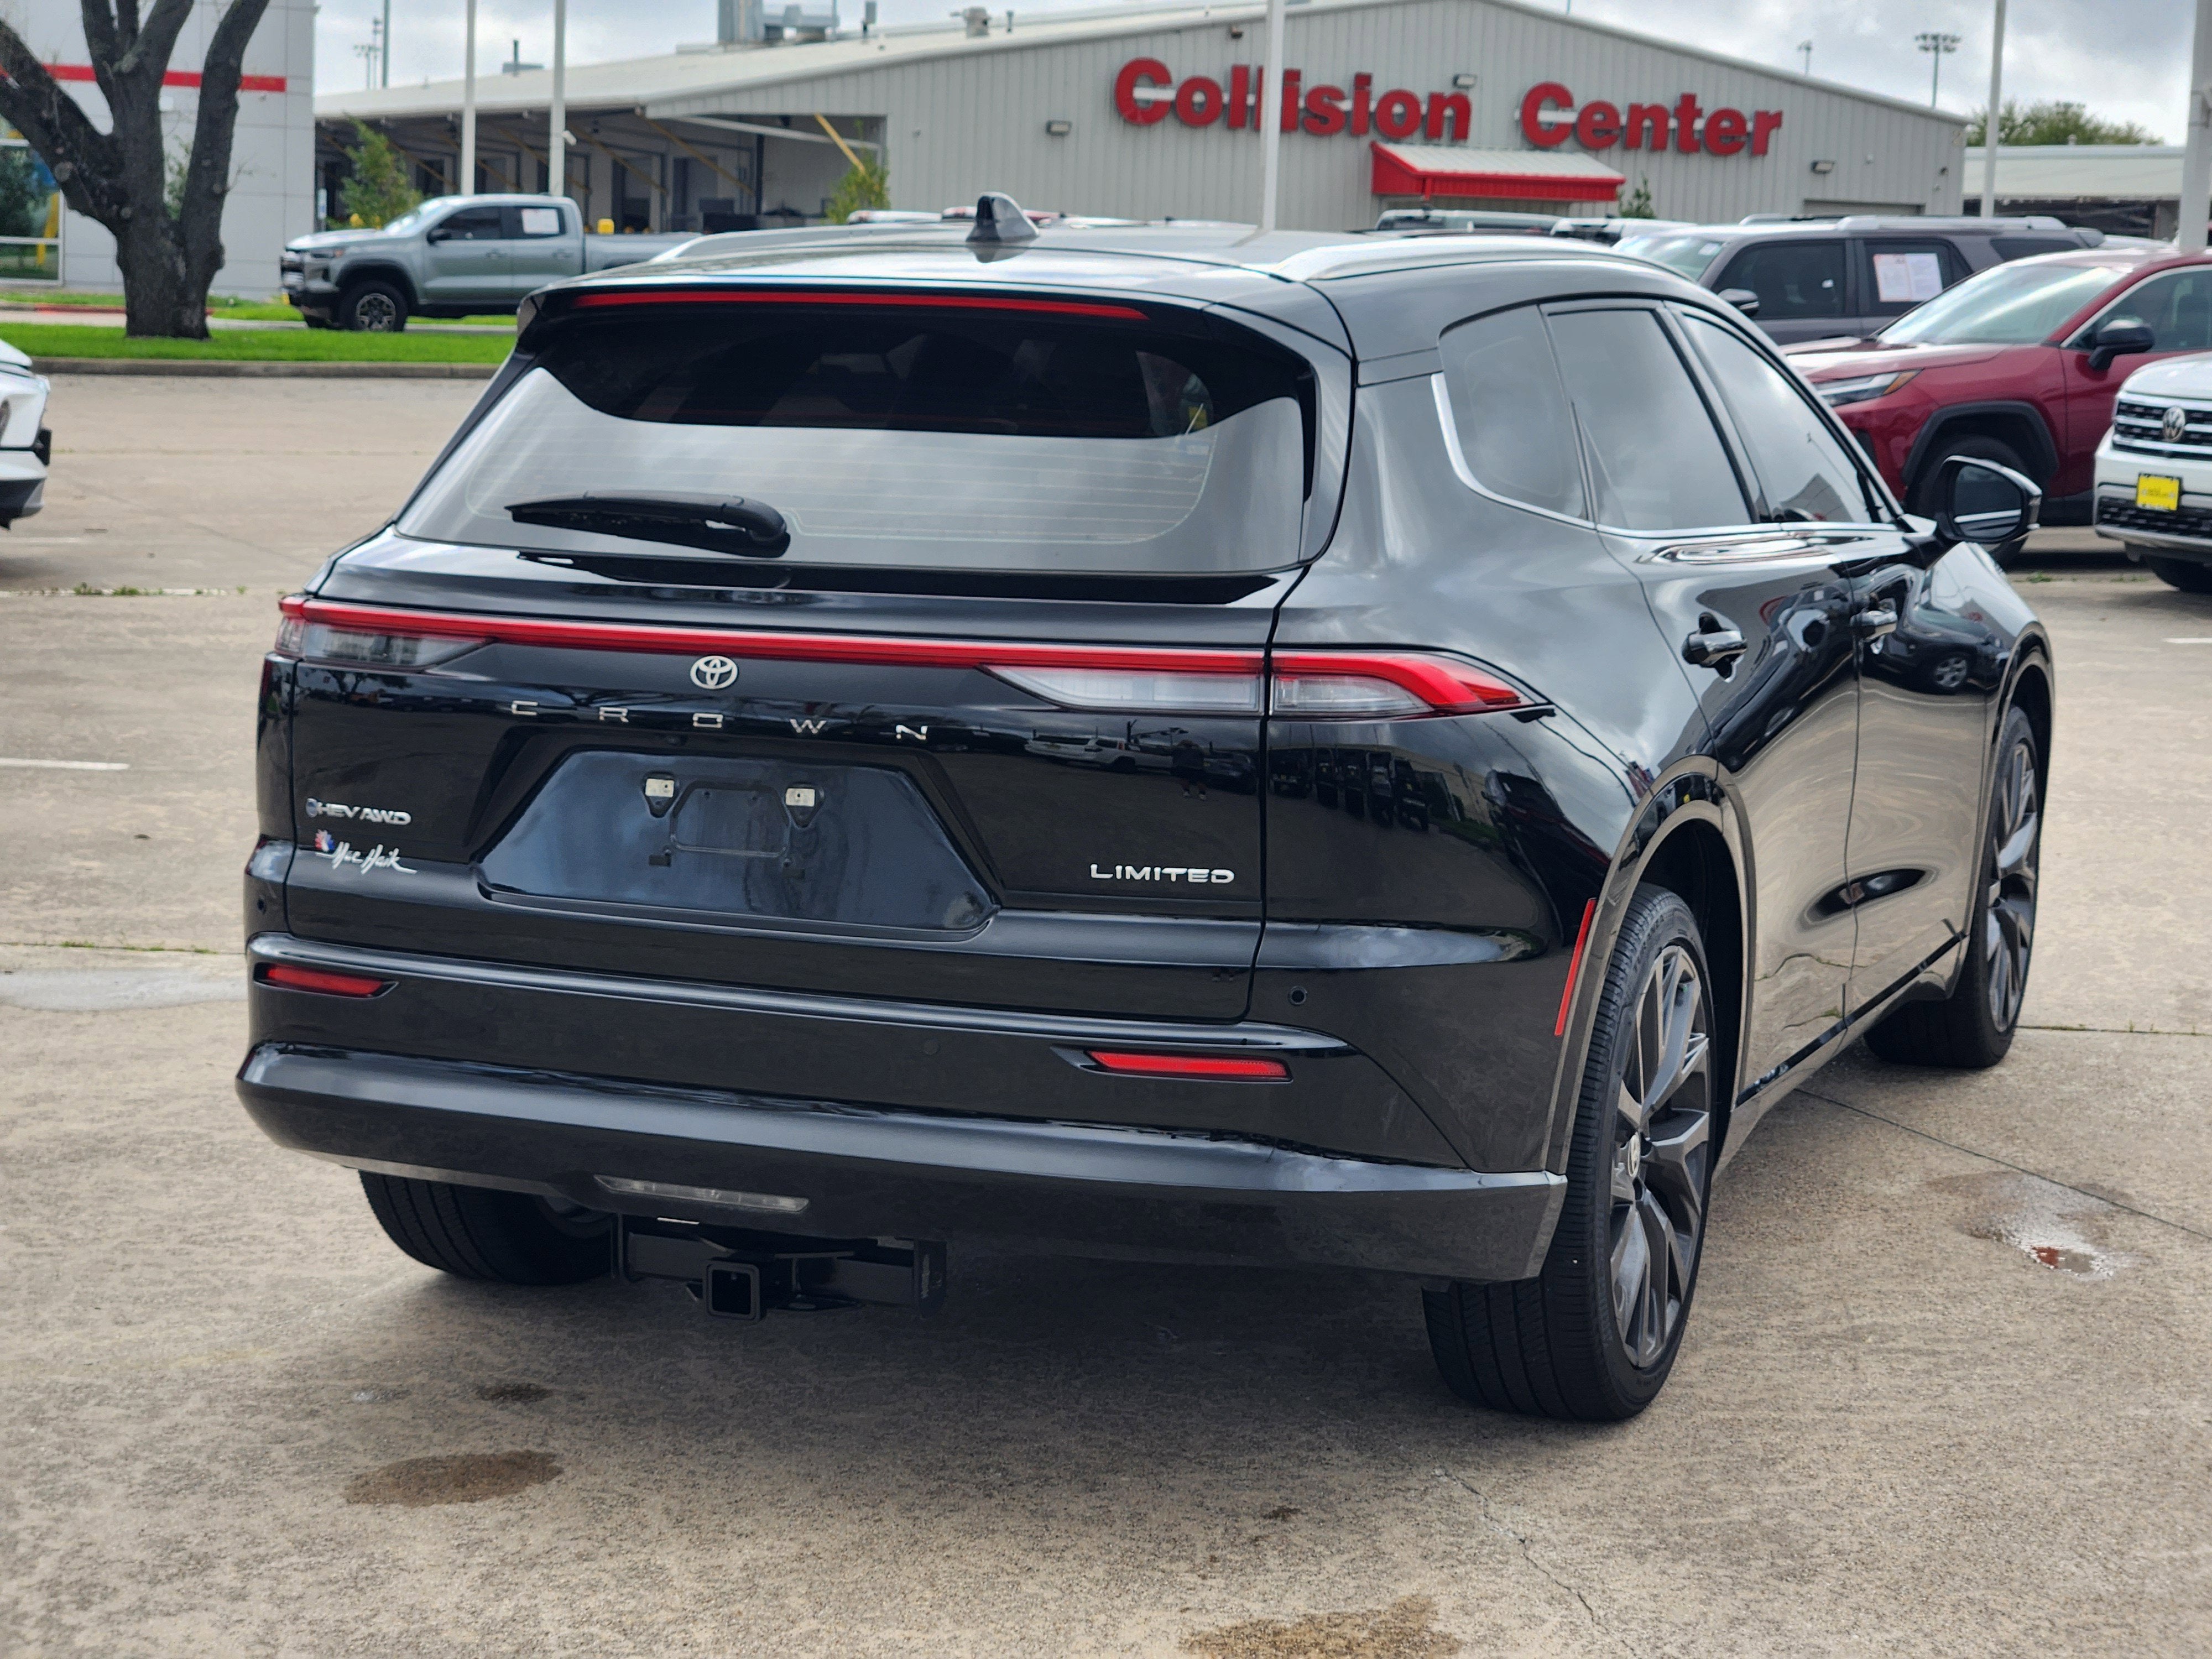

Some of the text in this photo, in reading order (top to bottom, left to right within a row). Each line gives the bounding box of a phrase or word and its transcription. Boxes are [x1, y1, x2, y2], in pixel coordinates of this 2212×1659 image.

[1521, 81, 1782, 155] Center
[511, 700, 928, 740] CROWN
[359, 807, 411, 825] AWD
[1090, 864, 1235, 884] LIMITED
